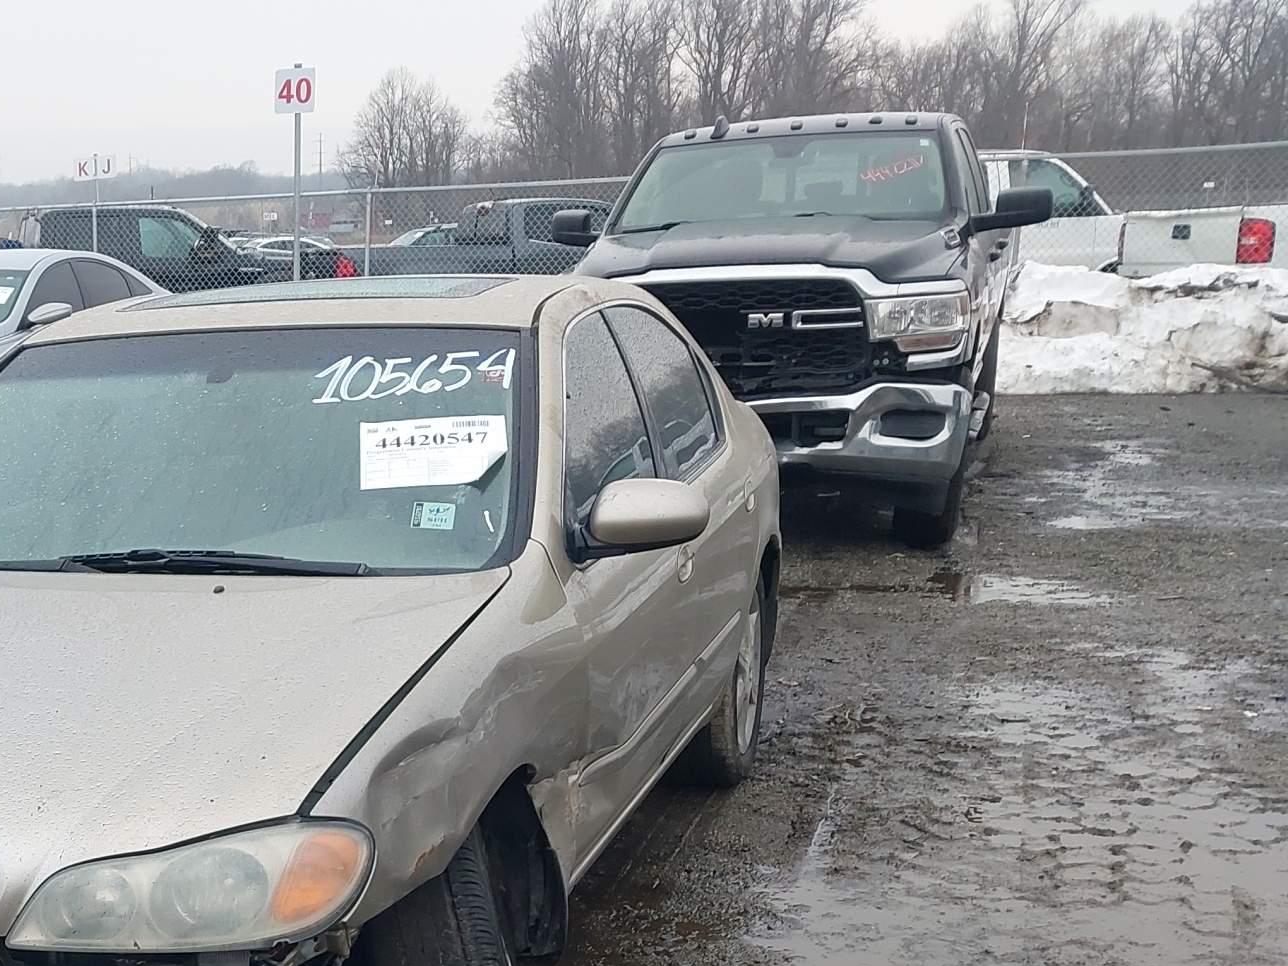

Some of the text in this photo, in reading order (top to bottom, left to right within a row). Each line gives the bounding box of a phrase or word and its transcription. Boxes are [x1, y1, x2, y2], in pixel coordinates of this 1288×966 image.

[279, 79, 312, 103] 40
[78, 159, 111, 176] K J
[312, 348, 516, 403] 105654
[376, 432, 488, 449] 44420547
